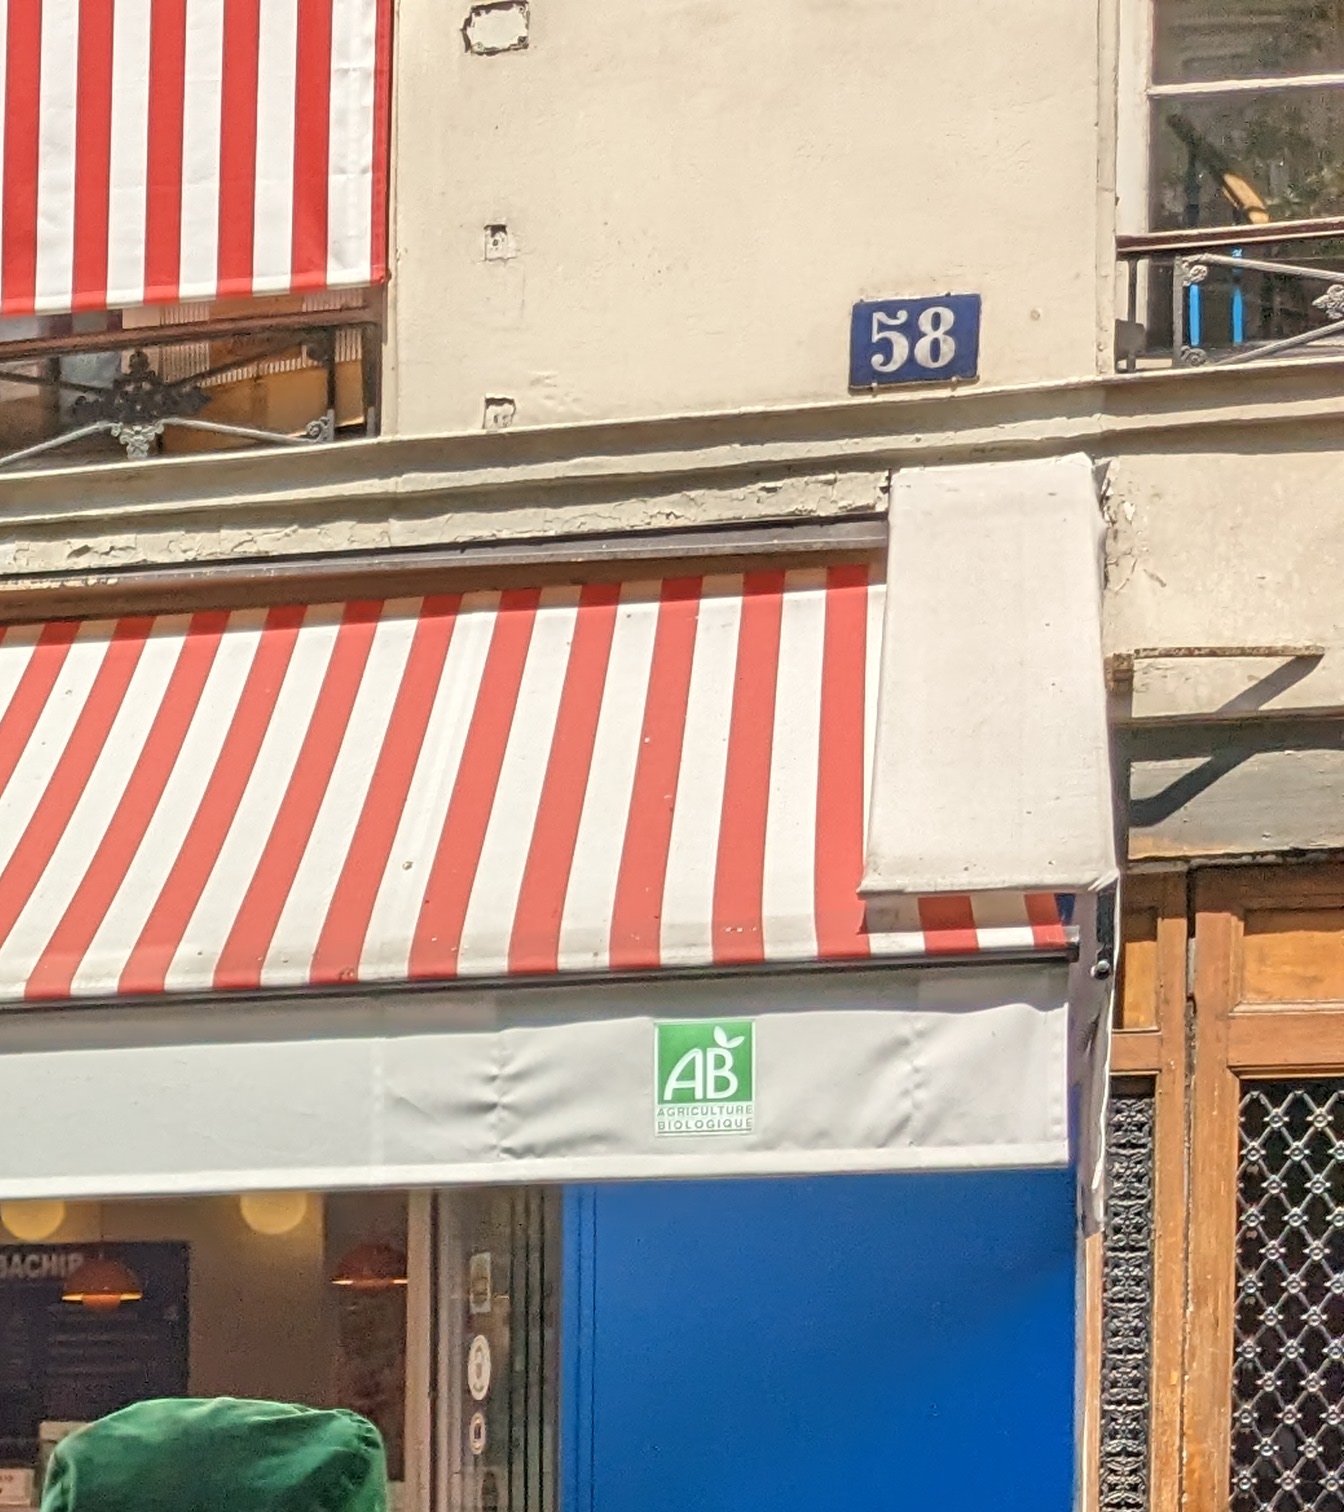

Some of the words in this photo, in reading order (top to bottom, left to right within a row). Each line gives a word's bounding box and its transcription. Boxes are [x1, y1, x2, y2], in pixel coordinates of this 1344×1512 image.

[871, 306, 956, 373] 58
[663, 1046, 739, 1101] AB
[657, 1104, 753, 1118] AGRICULTURE
[657, 1117, 753, 1131] BIOLOGIQUE
